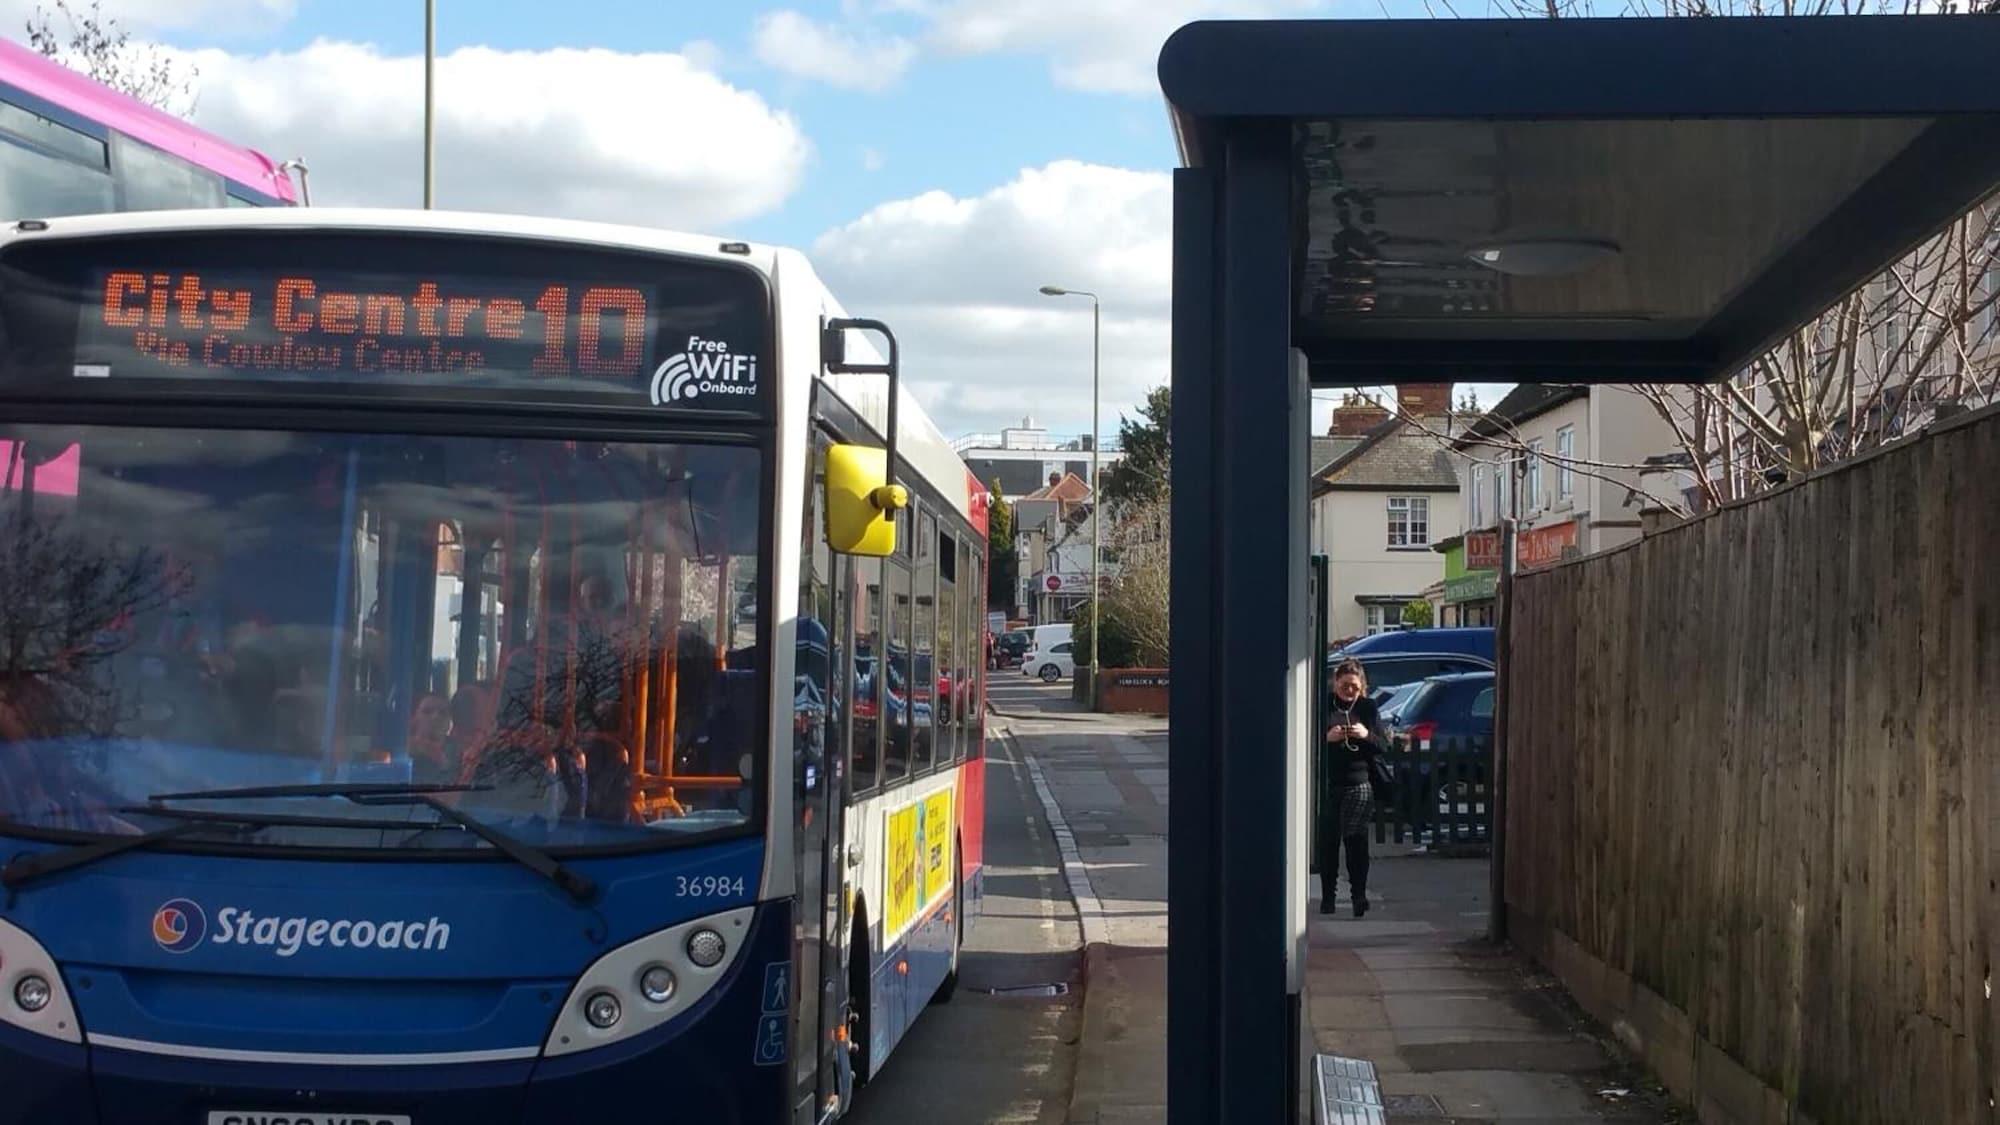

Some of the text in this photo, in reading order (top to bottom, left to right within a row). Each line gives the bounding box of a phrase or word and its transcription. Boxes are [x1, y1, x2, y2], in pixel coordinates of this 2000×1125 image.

[104, 272, 526, 340] City Centre
[532, 285, 647, 378] 10
[687, 335, 728, 353] Free
[135, 331, 485, 376] Via Cowley Centre
[687, 352, 757, 382] WiFi
[699, 380, 757, 395] Onboard
[675, 875, 745, 897] 36984
[211, 906, 451, 956] Stagecoach
